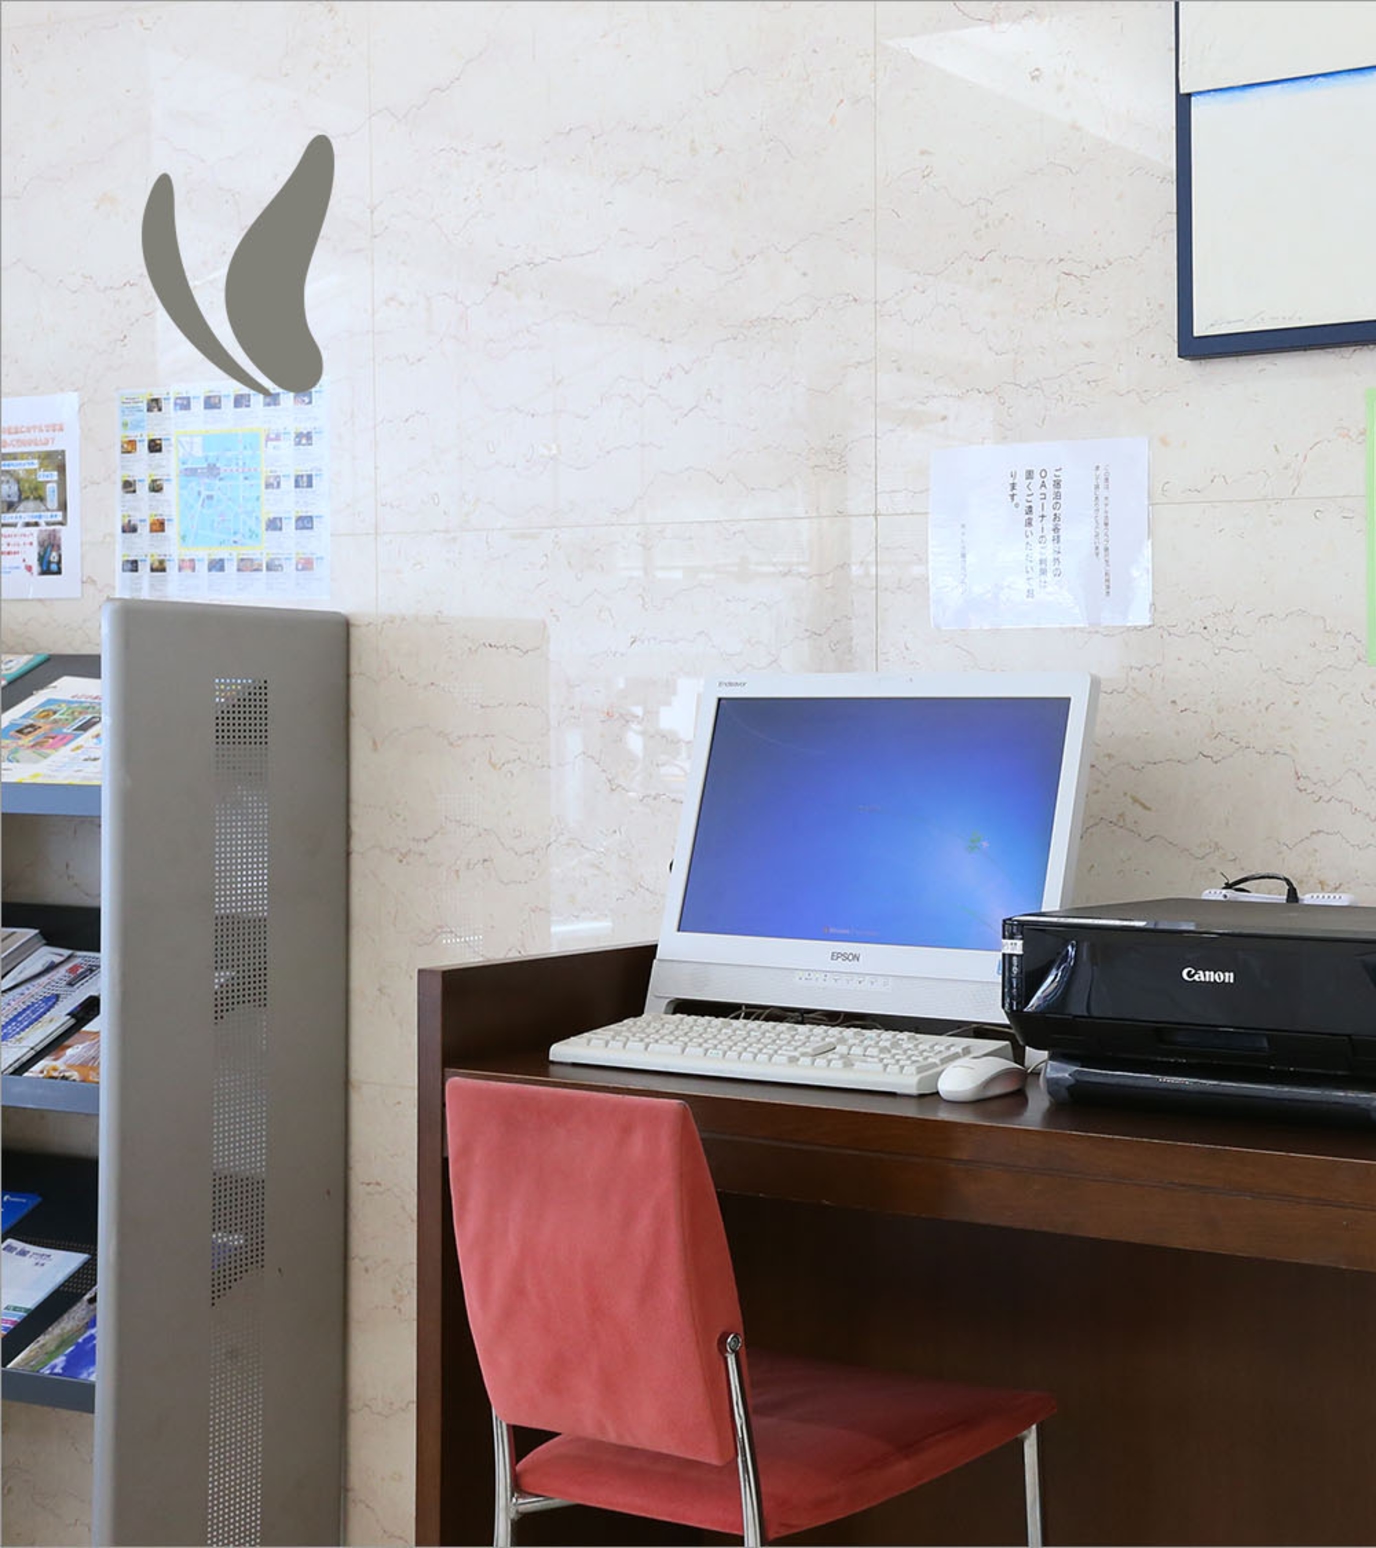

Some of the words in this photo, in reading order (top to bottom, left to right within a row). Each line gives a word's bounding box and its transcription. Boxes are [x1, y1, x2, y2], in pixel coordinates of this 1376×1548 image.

[1008, 470, 1021, 509] ります。
[1051, 467, 1063, 578] ご宿泊のお客様以外の
[830, 950, 861, 963] EPSON
[1181, 966, 1234, 984] Canon
